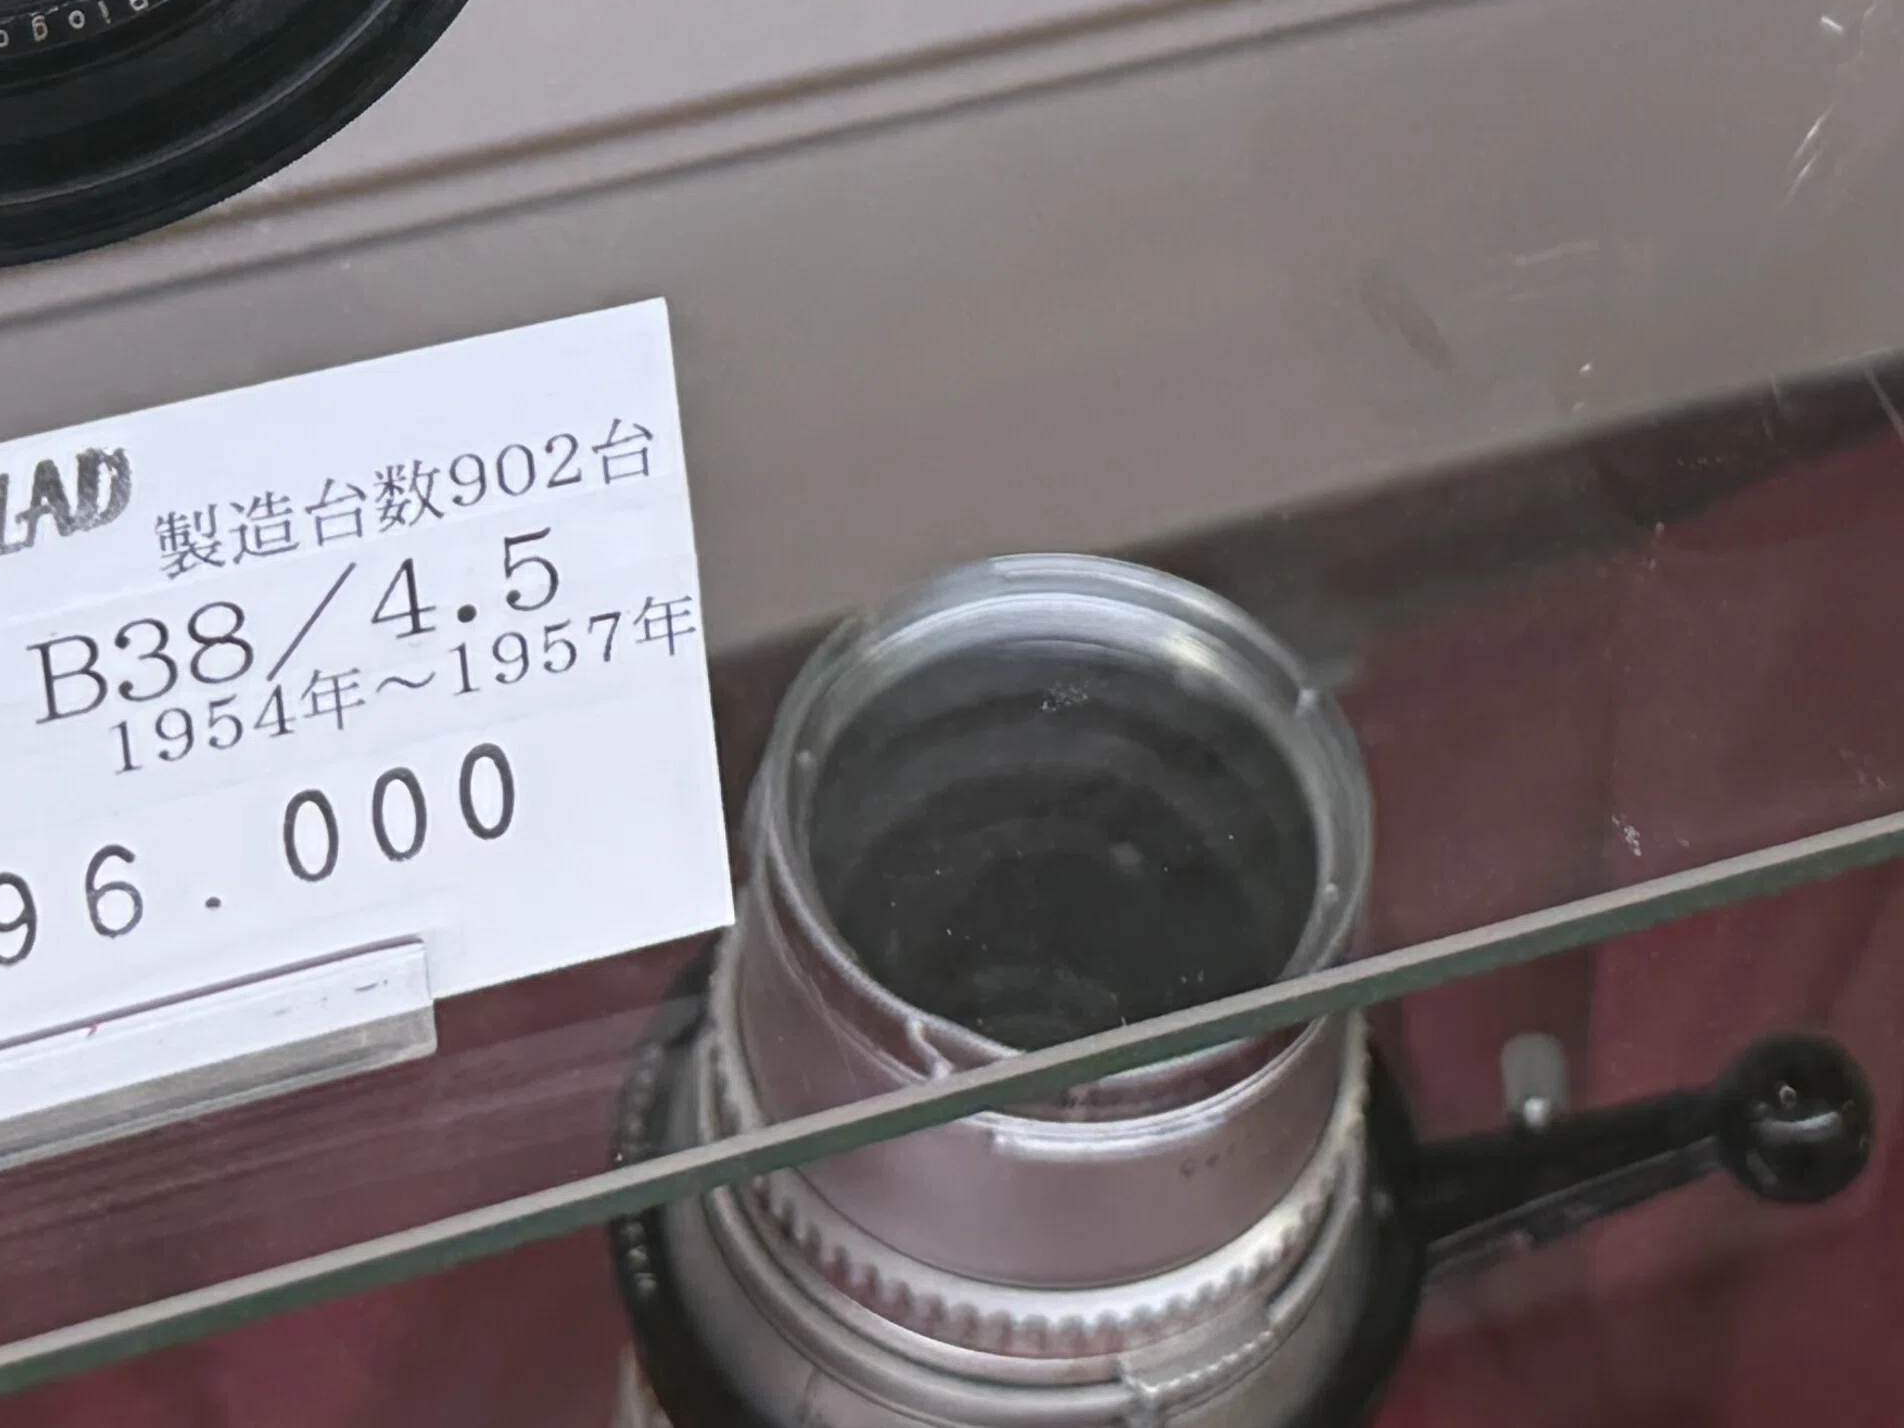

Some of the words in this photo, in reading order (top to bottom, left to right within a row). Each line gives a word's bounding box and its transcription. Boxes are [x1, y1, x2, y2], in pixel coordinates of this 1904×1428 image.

[154, 419, 656, 578] 製造台数902台
